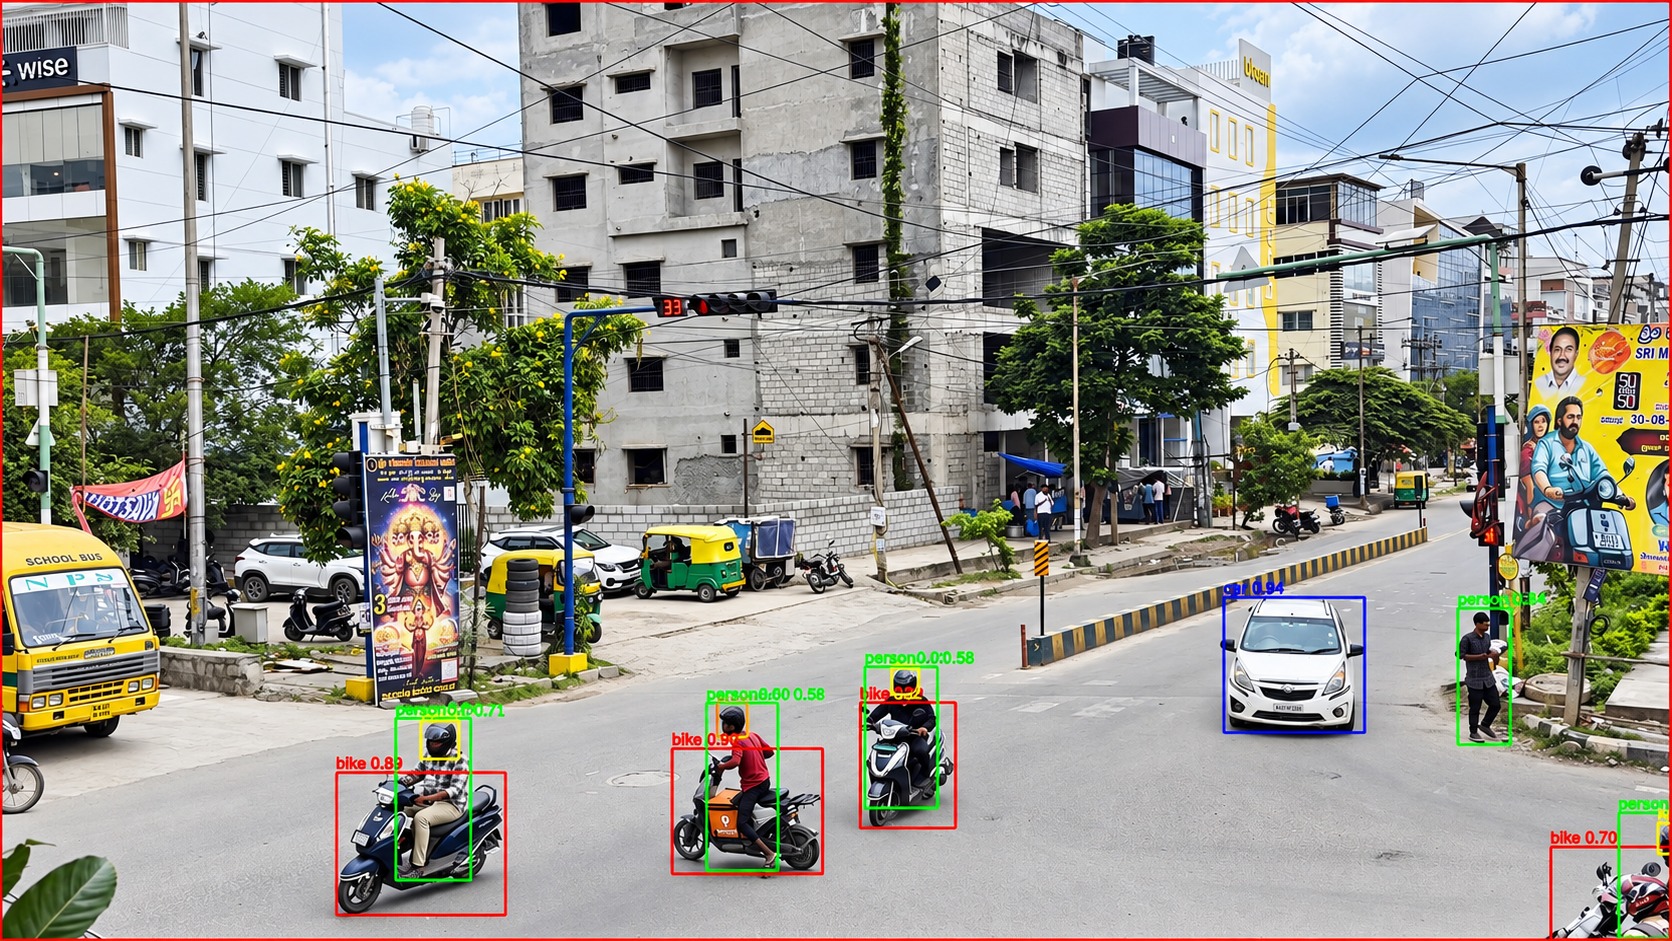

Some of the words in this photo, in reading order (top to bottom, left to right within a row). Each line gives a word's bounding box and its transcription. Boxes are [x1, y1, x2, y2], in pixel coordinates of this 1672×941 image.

[17, 57, 69, 80] wise
[663, 299, 682, 316] 33
[1635, 347, 1655, 359] SRI
[25, 553, 77, 567] SCHOOL
[79, 553, 103, 562] BUS
[374, 594, 386, 615] 3
